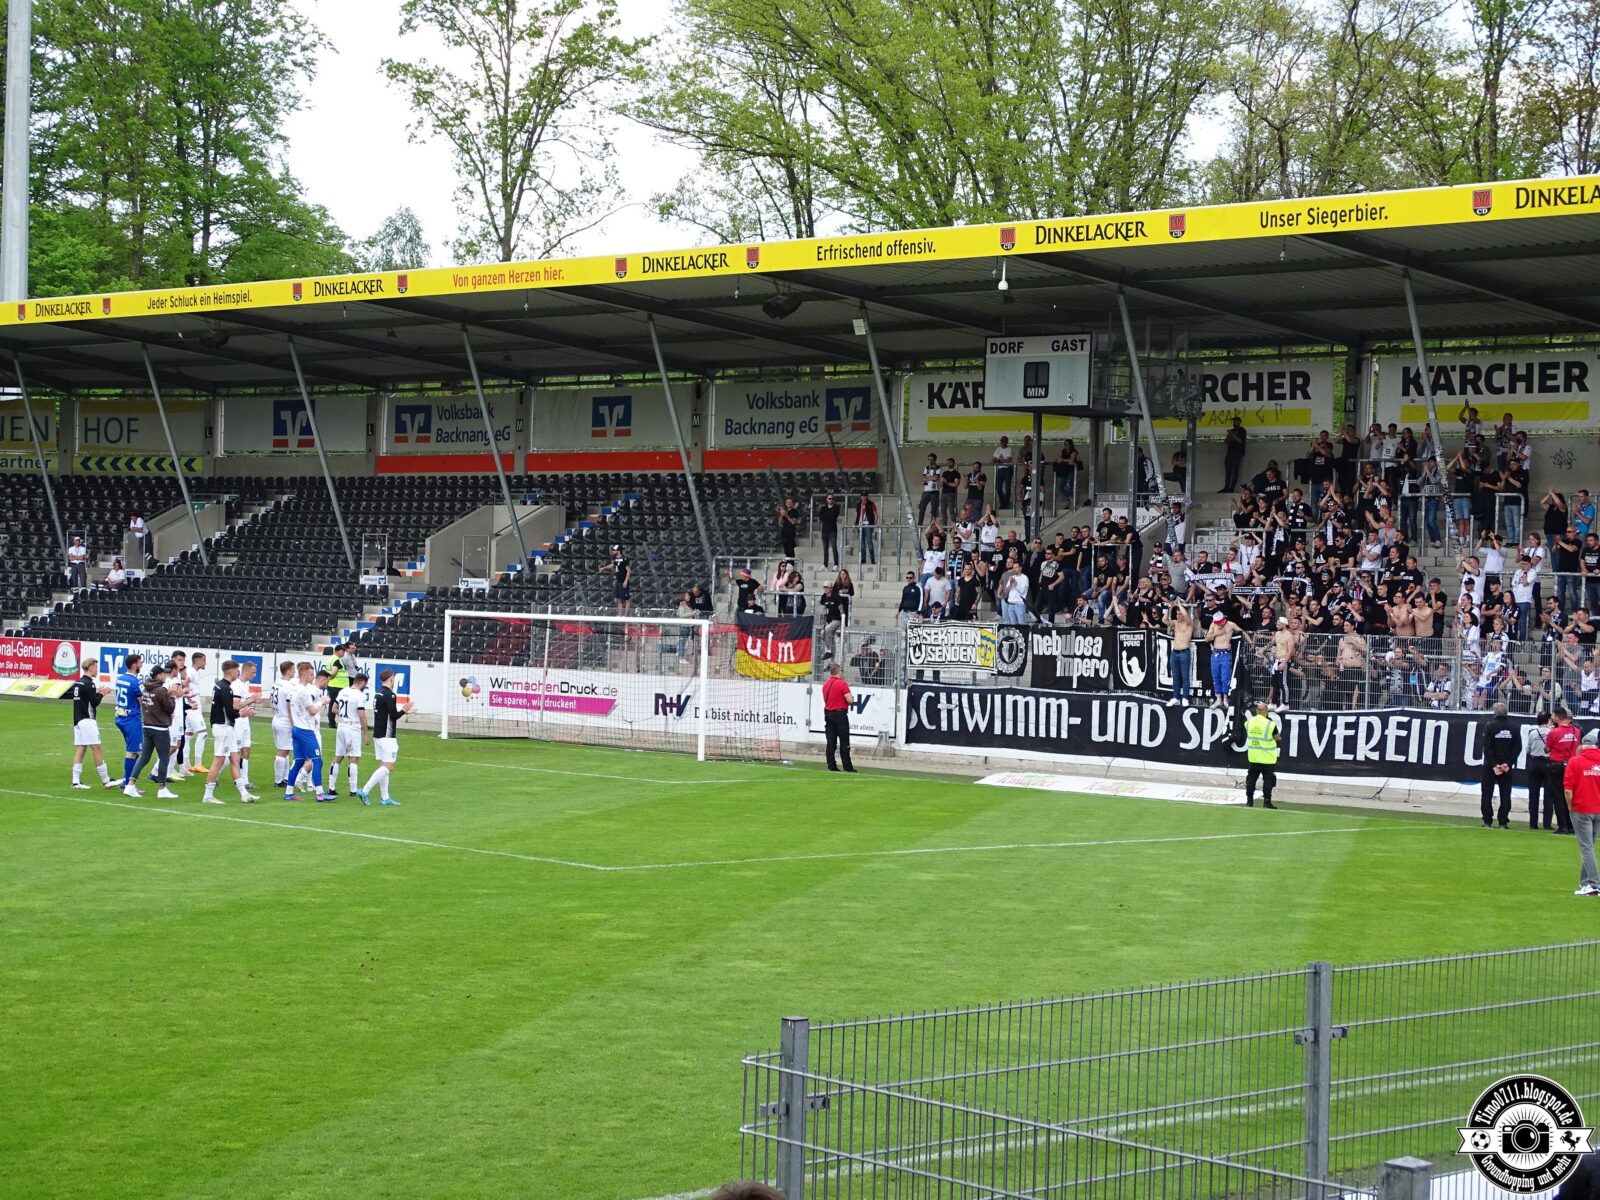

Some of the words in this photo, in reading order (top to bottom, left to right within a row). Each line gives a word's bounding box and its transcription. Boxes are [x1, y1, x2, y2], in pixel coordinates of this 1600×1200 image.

[1260, 209, 1302, 229] Unser
[1307, 203, 1389, 226] Siegerbier.
[1035, 220, 1148, 245] DINKELACKER
[816, 243, 883, 262] Erfrischend
[886, 240, 937, 257] offensiv.
[642, 253, 730, 274] DINKELACKER
[313, 279, 385, 297] DINKELACKER
[452, 273, 469, 288] Von
[471, 271, 506, 289] ganzem
[508, 268, 541, 284] Herzen
[543, 266, 565, 282] hier.
[35, 301, 93, 317] DINKELACKER
[147, 296, 168, 310] Jeder
[169, 293, 198, 308] Schluck
[199, 293, 211, 306] ein
[213, 290, 253, 306] Heimspiel.
[990, 341, 1024, 354] DORF
[1051, 338, 1087, 352] GAST
[1200, 370, 1312, 403] RCHER
[1401, 360, 1590, 397] KÄRCHER
[746, 389, 820, 410] Volksbank
[1027, 386, 1045, 397] MIN
[436, 402, 495, 421] Volksbak
[83, 417, 139, 444] HOF
[435, 426, 491, 446] Backnang
[495, 425, 511, 442] eG
[725, 417, 795, 439] Backnang
[799, 416, 818, 433] eG
[746, 630, 795, 663] ulm
[923, 628, 981, 646] SEKTION
[1032, 629, 1103, 658] nebulosa
[926, 646, 976, 663] SENDEN
[1056, 653, 1109, 688] impero
[489, 676, 618, 697] WirmachenDruck.de
[492, 694, 503, 704] Sie
[504, 697, 531, 708] sparen,
[544, 698, 577, 709] drucken!
[653, 692, 691, 717] R+V
[711, 707, 731, 721] bist
[733, 709, 763, 723] nicht
[763, 710, 797, 726] allein.
